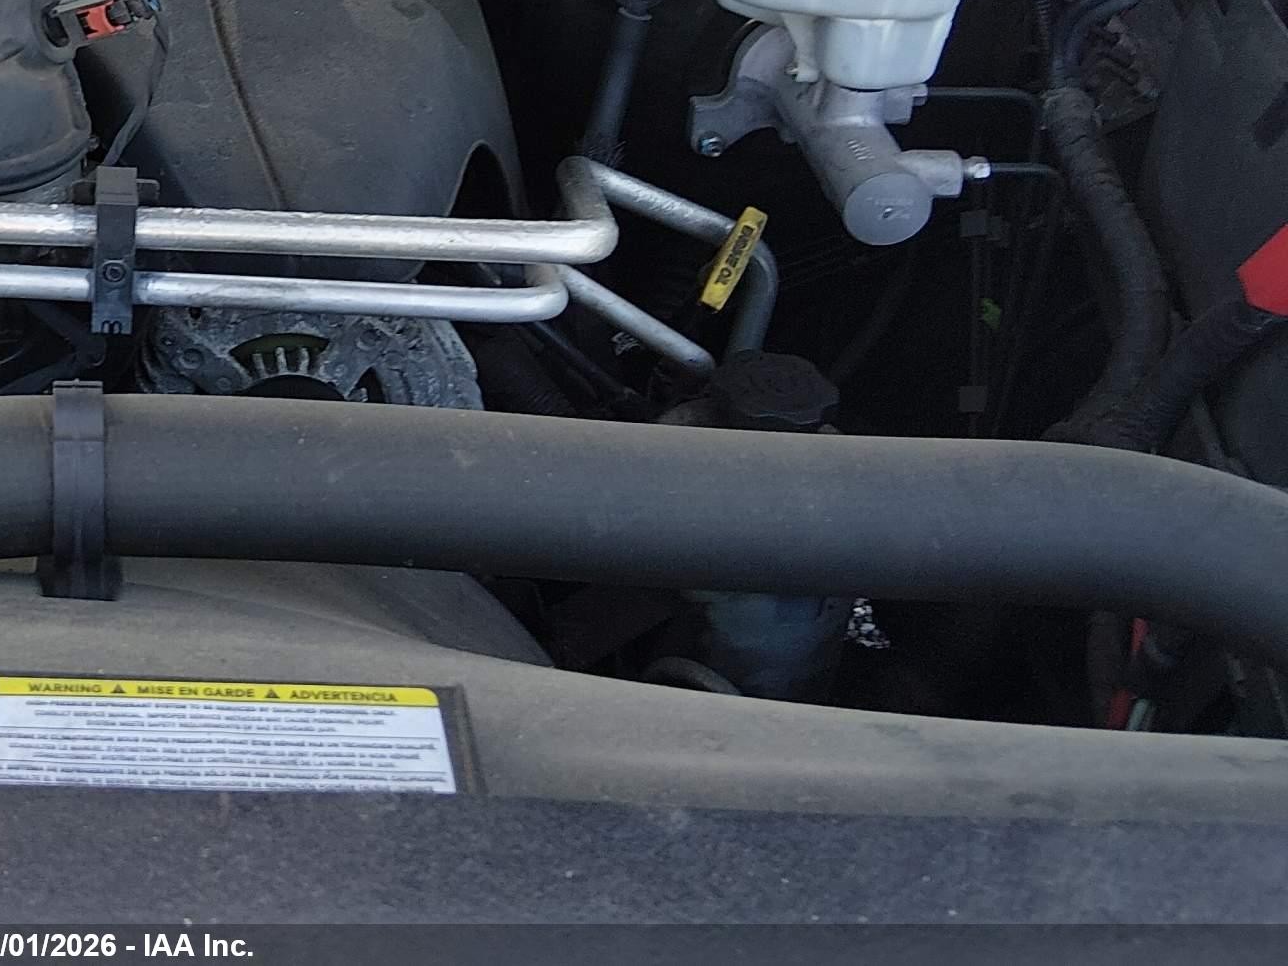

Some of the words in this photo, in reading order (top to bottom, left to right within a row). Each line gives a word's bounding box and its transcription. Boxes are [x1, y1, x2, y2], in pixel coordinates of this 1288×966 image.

[28, 681, 102, 694] WARNING
[137, 685, 174, 696] MISE
[179, 686, 198, 697] EN
[203, 686, 255, 699] GARDE
[289, 689, 398, 702] ADVERTENCIA
